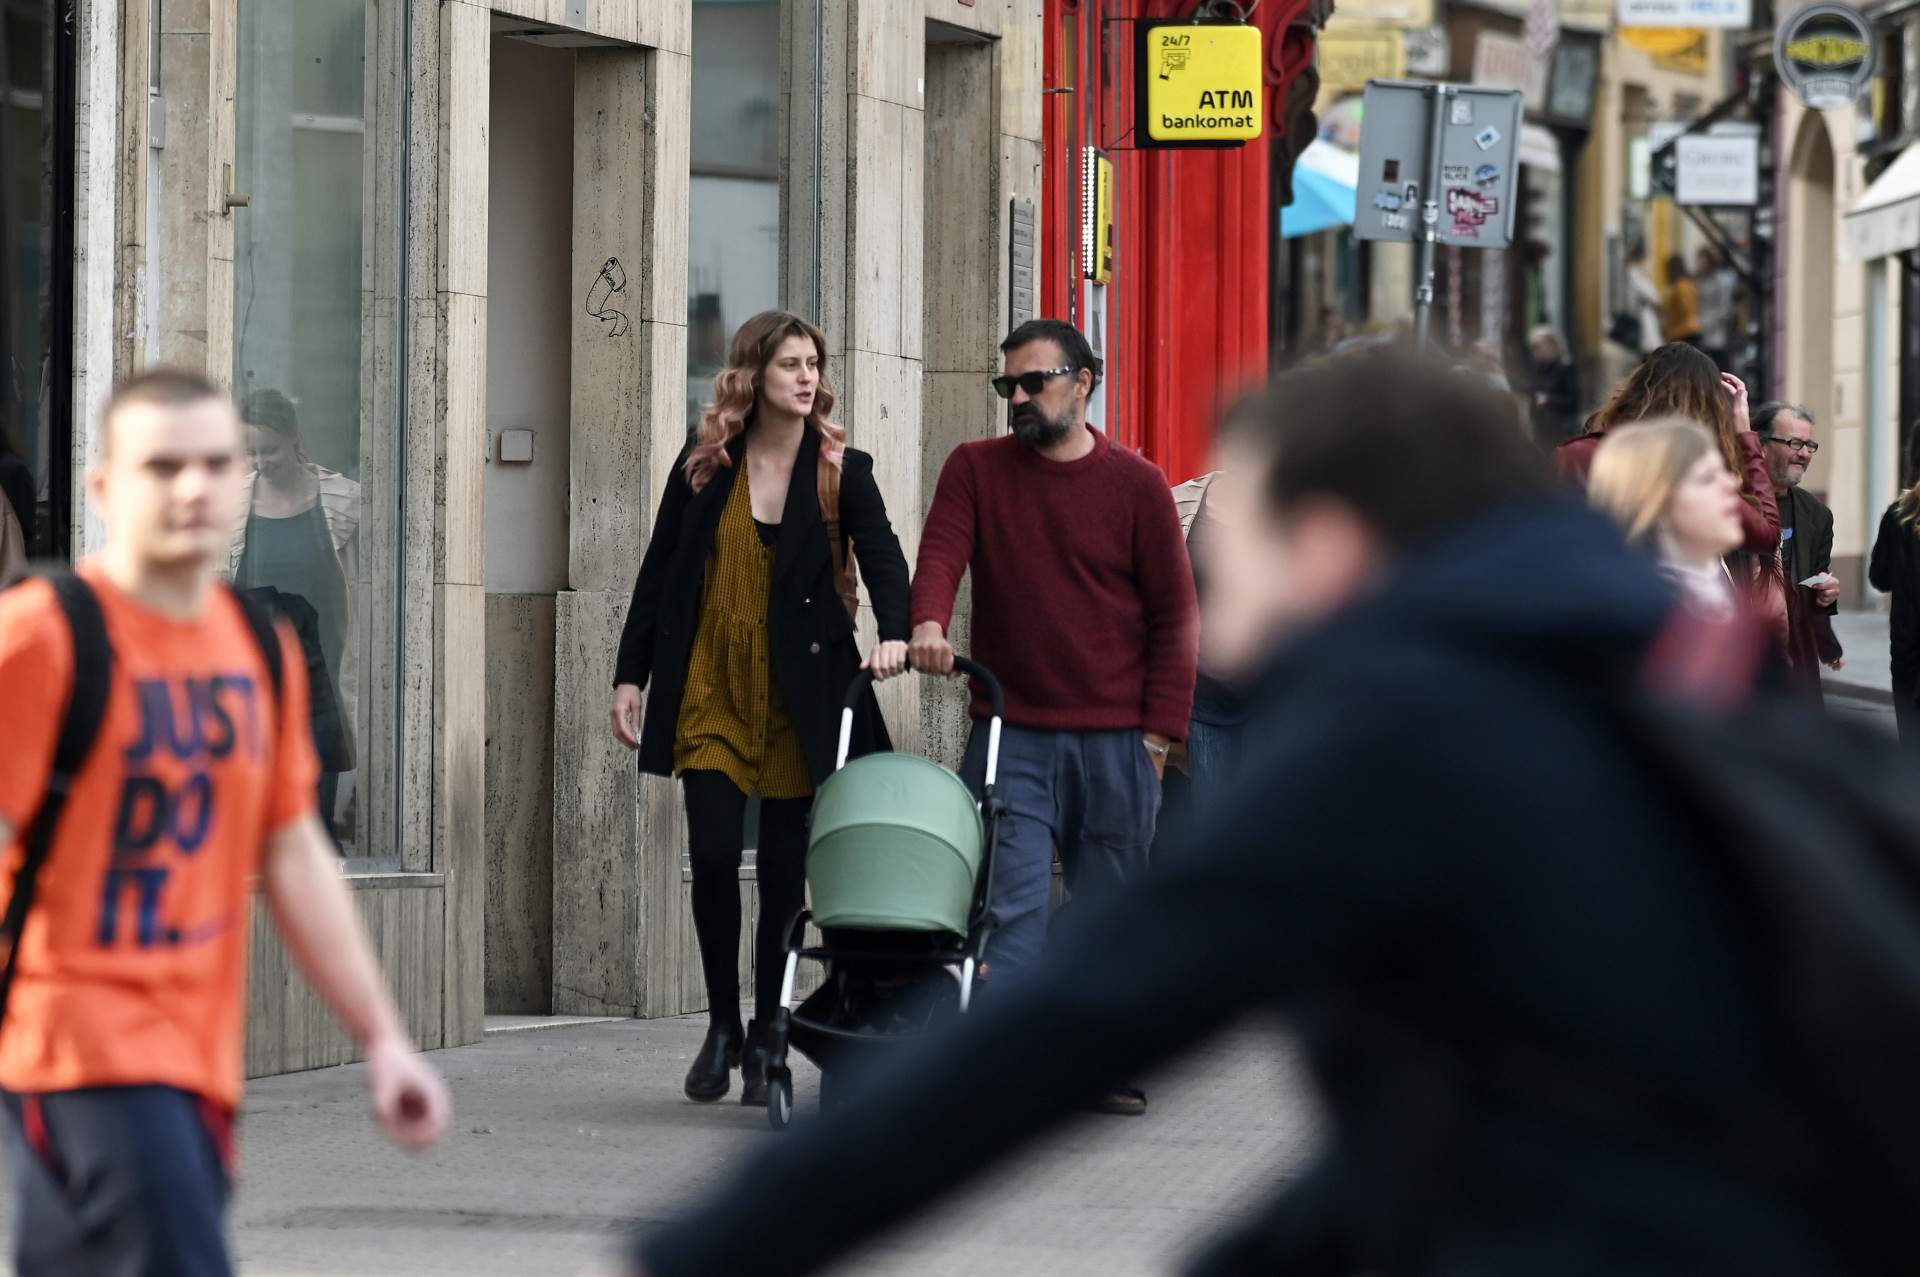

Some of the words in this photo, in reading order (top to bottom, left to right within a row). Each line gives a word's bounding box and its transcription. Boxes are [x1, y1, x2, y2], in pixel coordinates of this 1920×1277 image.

[1162, 35, 1191, 46] 24/7
[1199, 90, 1253, 109] ATM
[1162, 114, 1253, 129] bankomat
[125, 673, 258, 760] JUST
[112, 770, 215, 854] DO
